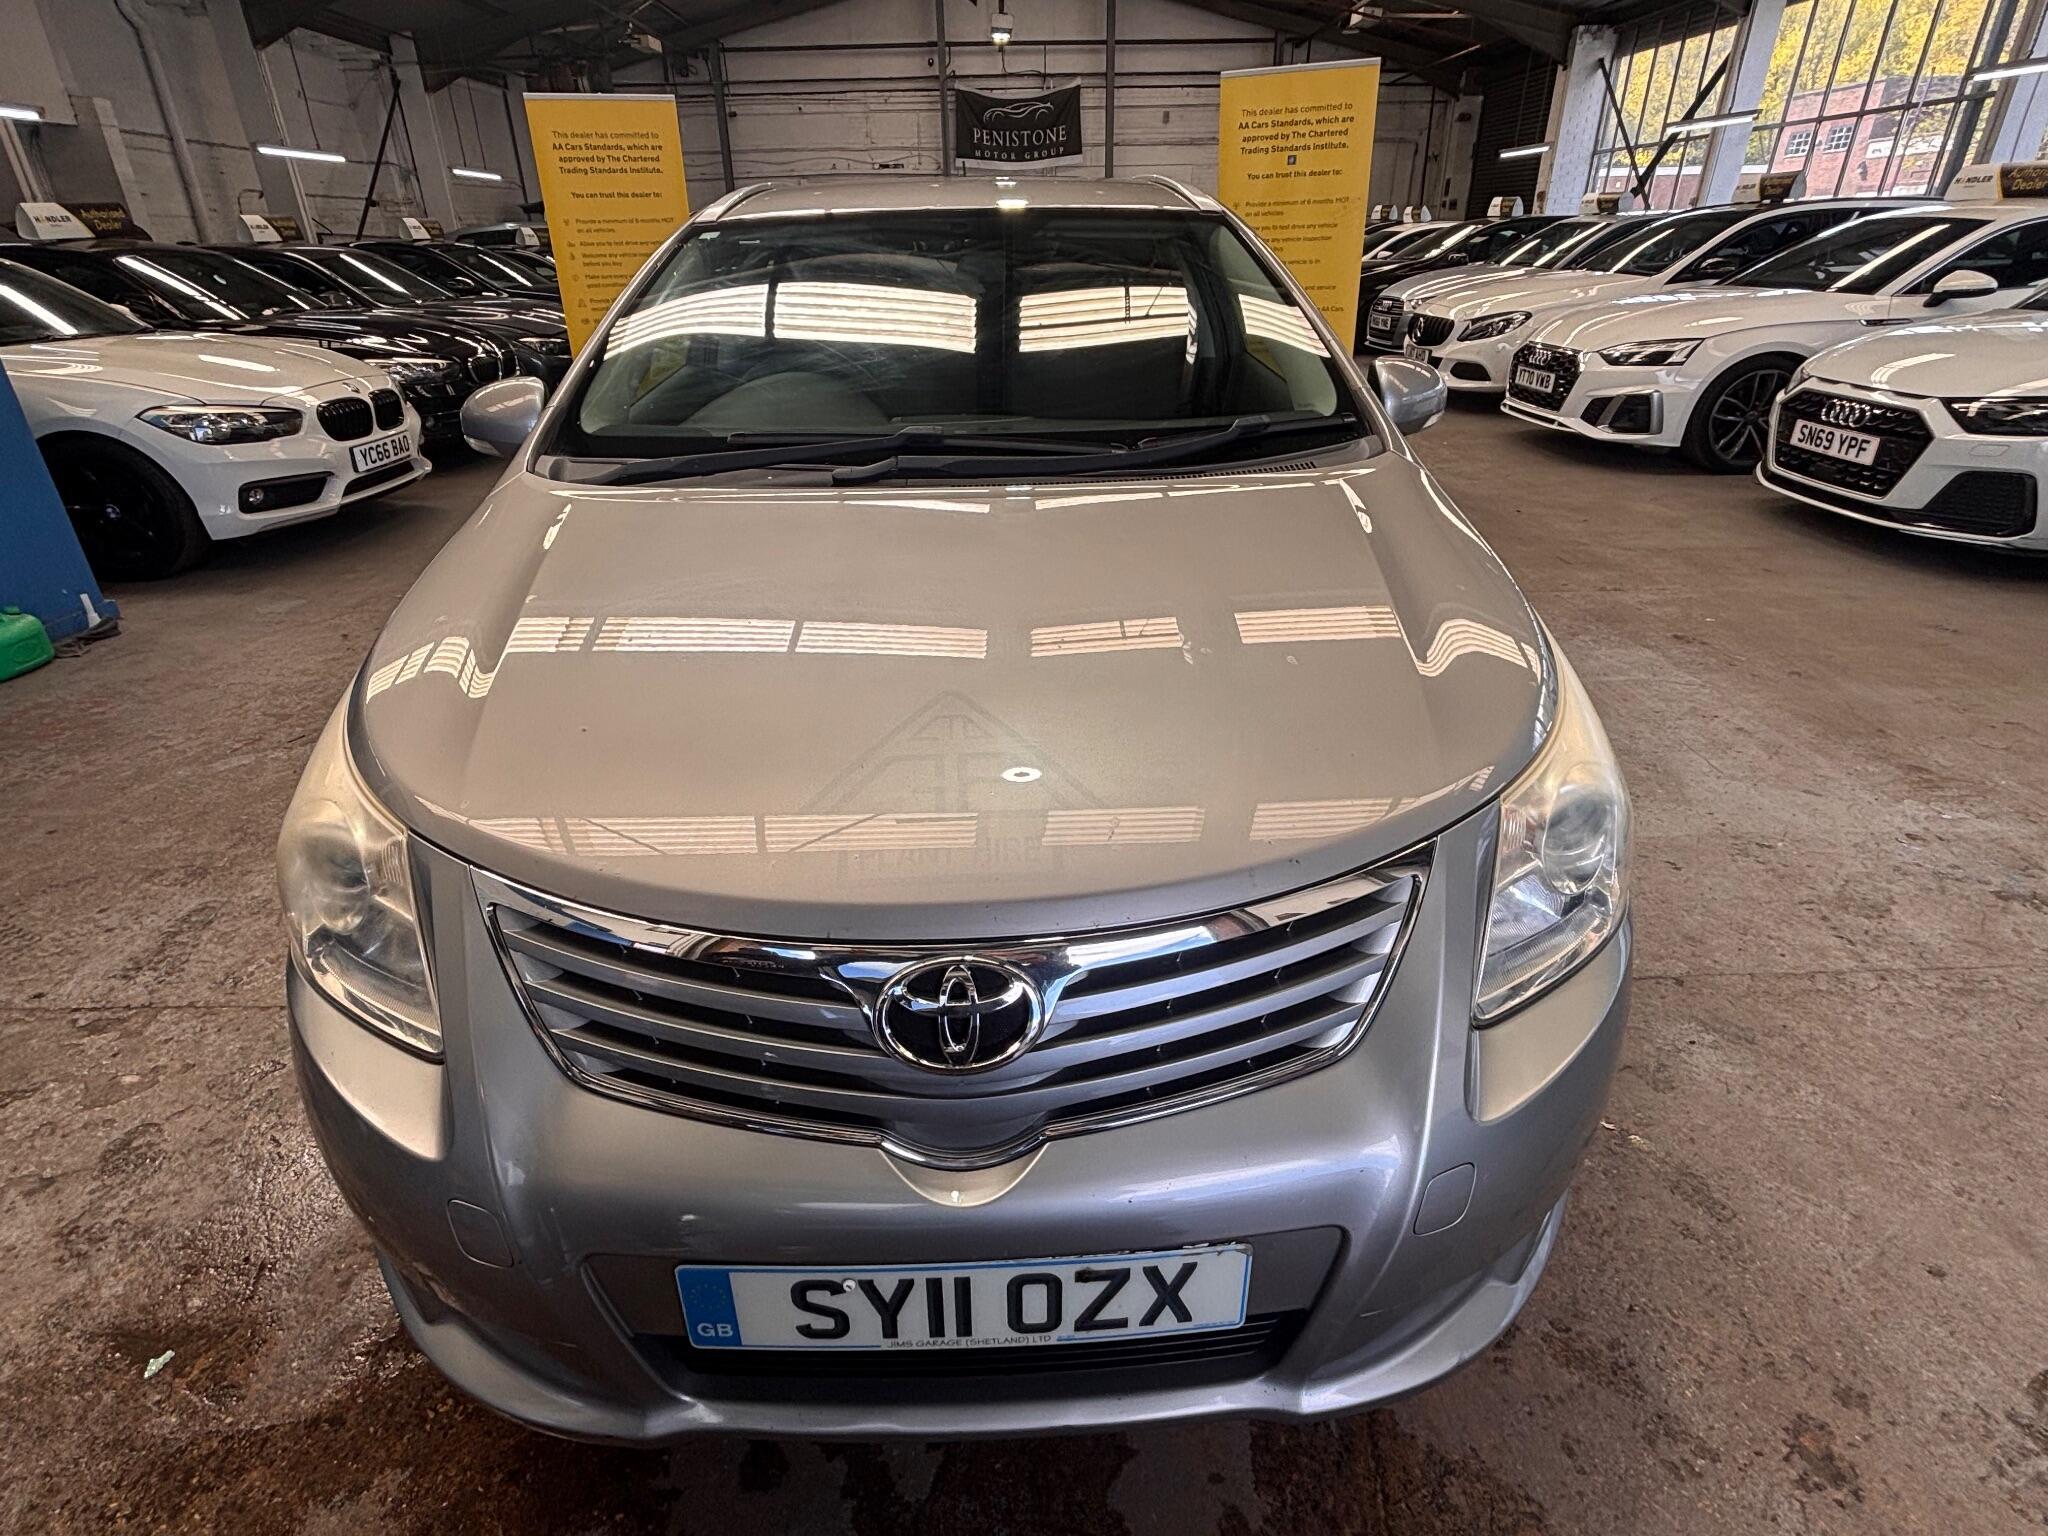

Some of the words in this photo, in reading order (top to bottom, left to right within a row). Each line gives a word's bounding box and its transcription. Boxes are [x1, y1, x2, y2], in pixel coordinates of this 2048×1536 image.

[1242, 109, 1257, 117] This
[1259, 108, 1282, 116] dealer
[1300, 103, 1342, 113] committed
[1345, 102, 1353, 110] to
[1238, 122, 1250, 130] AA
[1251, 120, 1269, 129] Cars
[1315, 116, 1340, 125] which
[552, 130, 568, 138] This
[570, 130, 594, 138] dealer
[595, 130, 609, 138] has
[610, 130, 649, 139] committed
[651, 131, 659, 139] to
[972, 125, 1068, 146] PENISTONE
[1242, 132, 1279, 143] approved
[1280, 132, 1290, 141] by
[1292, 131, 1306, 139] The
[1308, 128, 1349, 138] Chartered
[552, 143, 564, 151] AA
[564, 143, 583, 151] Cars
[626, 143, 650, 151] which
[1240, 146, 1269, 155] Trading
[1271, 142, 1311, 153] Standards
[559, 155, 594, 163] approved
[975, 150, 1016, 160] MOTOR
[1024, 148, 1064, 158] GROUP
[559, 167, 588, 175] Trading
[1247, 172, 1260, 180] You
[1276, 170, 1292, 178] trust
[1308, 169, 1331, 177] dealer
[1798, 424, 1834, 450] SN69
[1838, 432, 1871, 458] YPF
[360, 442, 390, 466] YC66
[790, 1277, 972, 1339] SY11
[1007, 1262, 1198, 1334] OZX
[697, 1322, 733, 1337] GB
[916, 1338, 962, 1348] GARAGE
[966, 1336, 1029, 1347] (SHETLAND)
[1032, 1335, 1051, 1343] LTD
